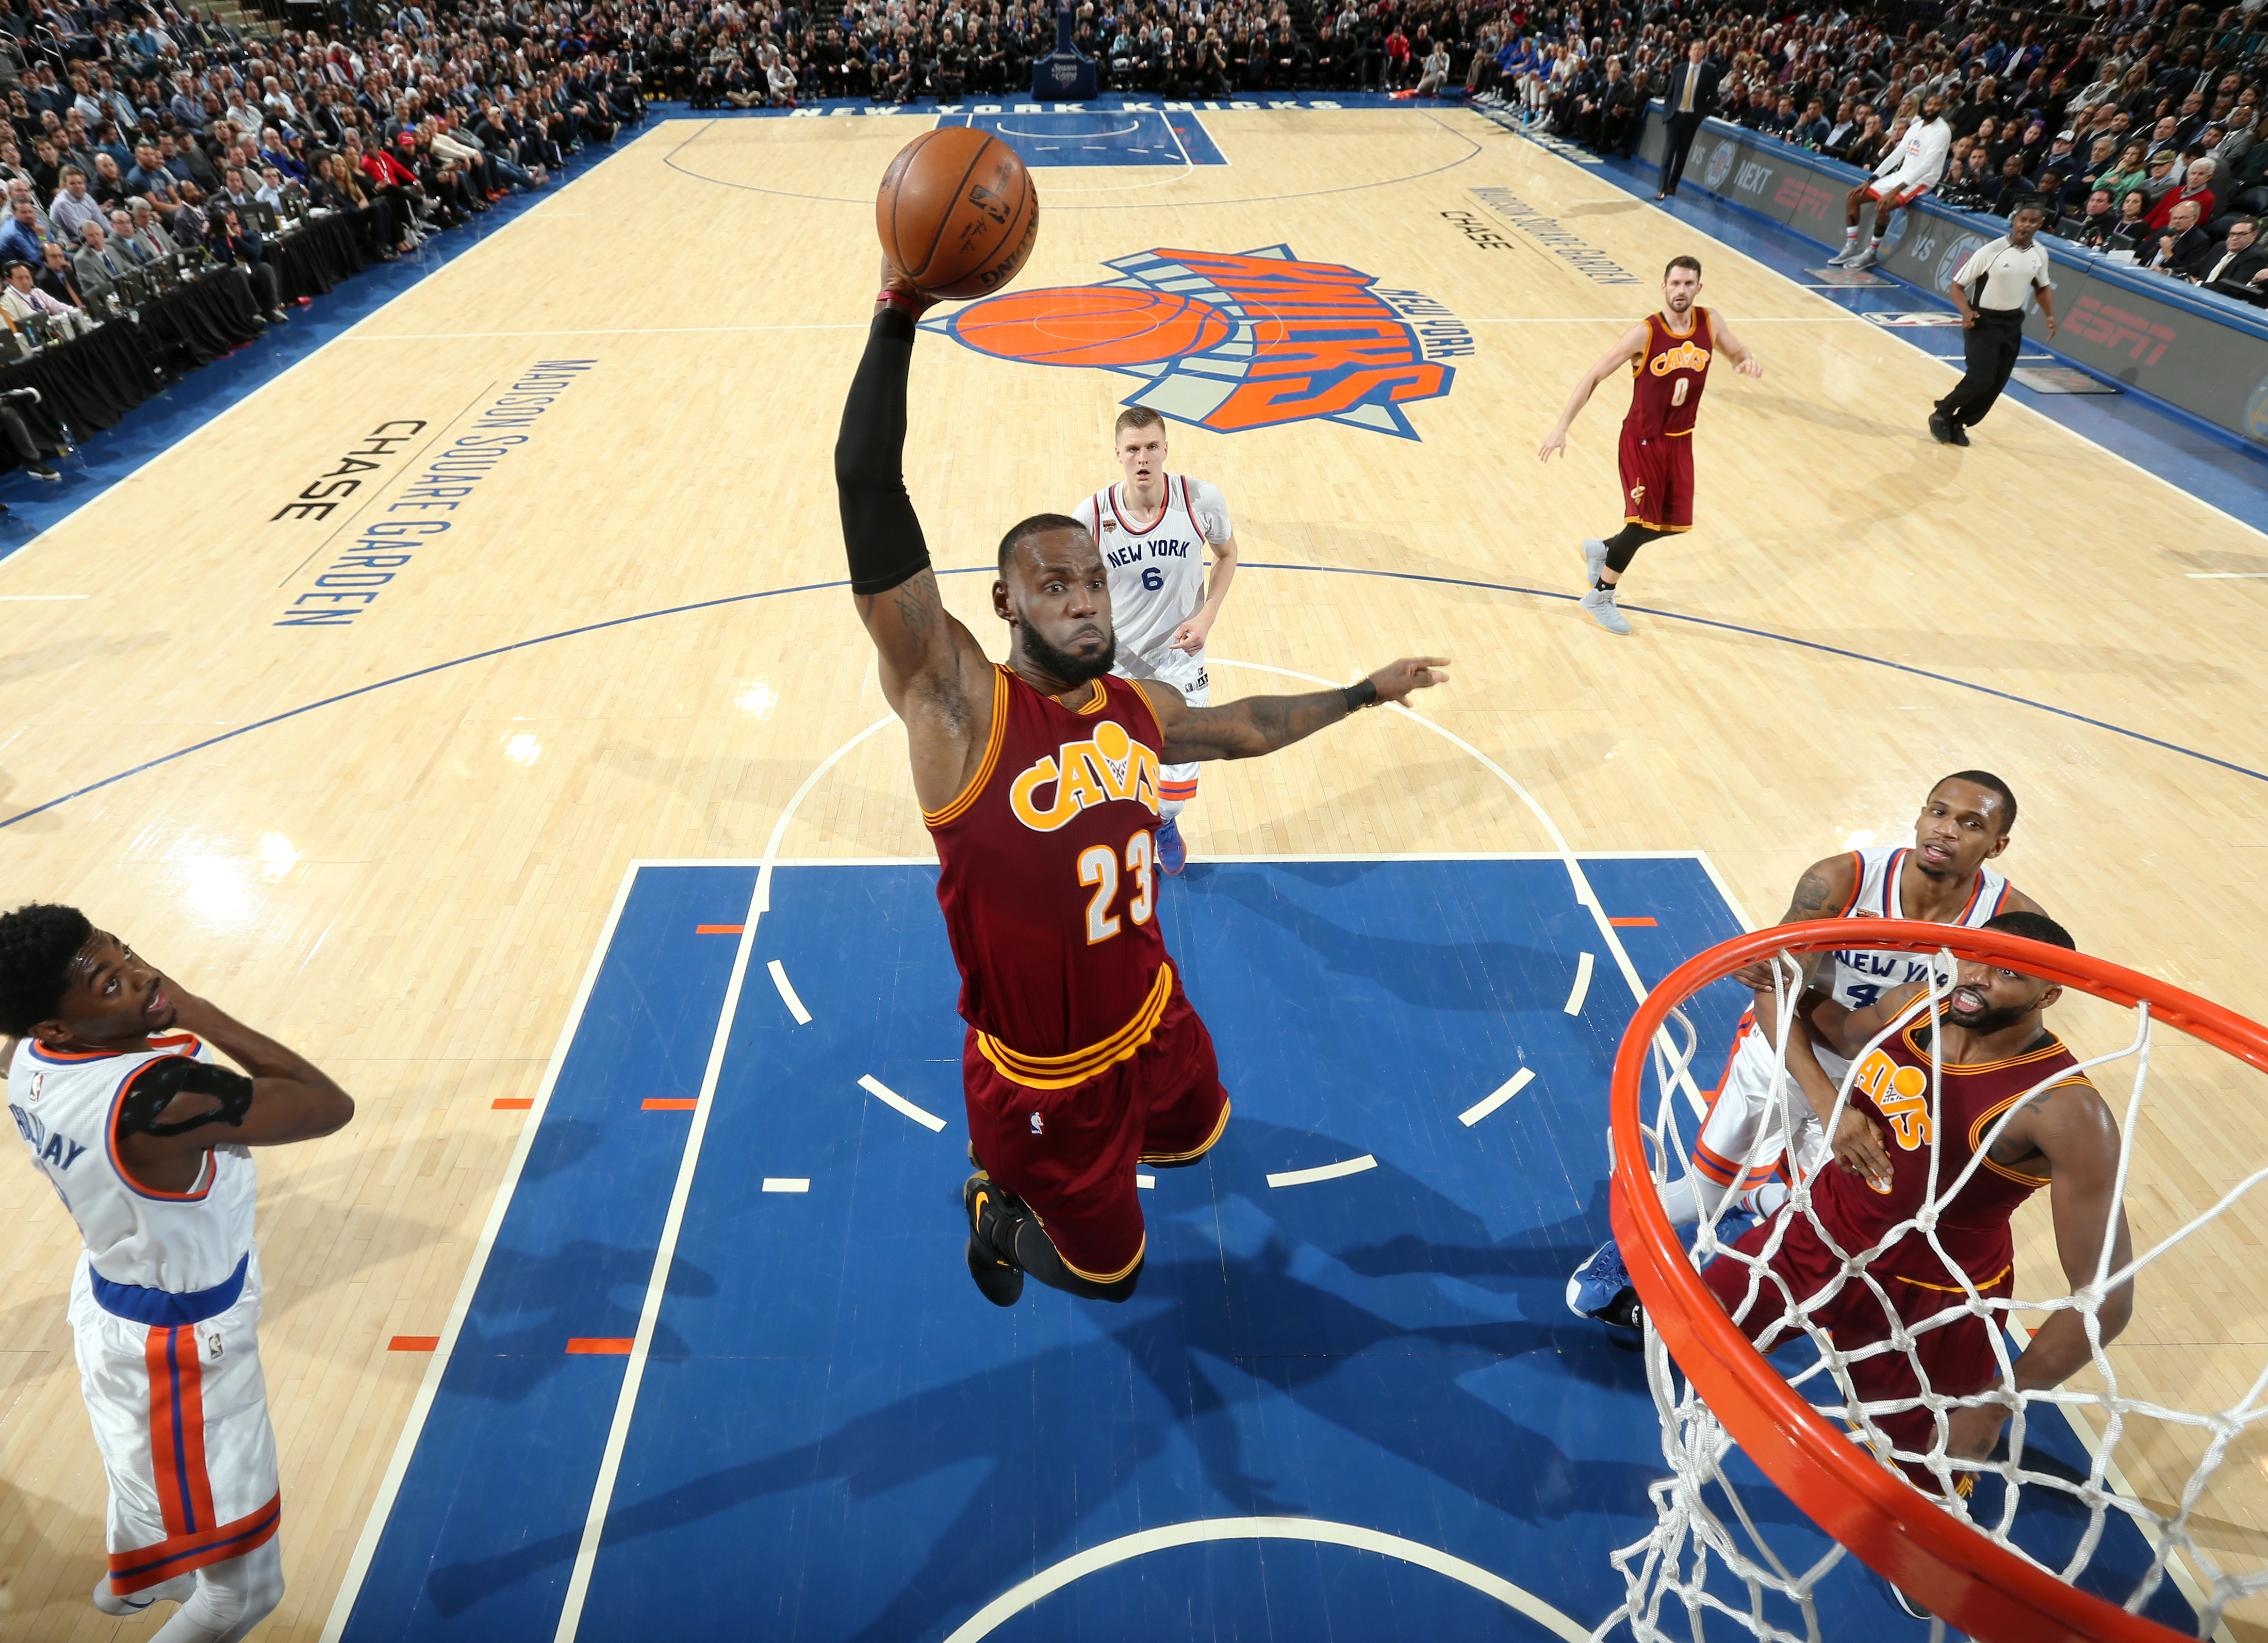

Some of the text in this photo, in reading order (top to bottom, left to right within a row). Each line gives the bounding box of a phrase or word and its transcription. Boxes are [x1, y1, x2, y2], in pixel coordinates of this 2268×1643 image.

[789, 101, 1342, 117] NEW YORK KNICKS
[1691, 145, 1706, 165] VS
[1733, 159, 1834, 221] NEXT ESPN
[1440, 210, 1516, 250] CHASE
[1510, 217, 1588, 247] SQUARE
[1554, 249, 1645, 285] GARDEN
[1911, 235, 1935, 261] VS
[1150, 247, 1445, 431] KNICKS
[1371, 288, 1475, 359] NEW YORK
[2061, 295, 2176, 366] ESPN
[1650, 340, 1711, 376] CAVS
[1671, 377, 1689, 406] 0
[267, 420, 427, 522] CHASE
[271, 359, 599, 626] MADISON SQUARE GARDEN
[1107, 539, 1191, 569] NEW YORK
[1141, 567, 1164, 592] 6
[1009, 720, 1160, 832] CAVS
[1076, 829, 1155, 945] 23
[1847, 984, 1881, 1009] 4
[1854, 1047, 1932, 1151] AVS
